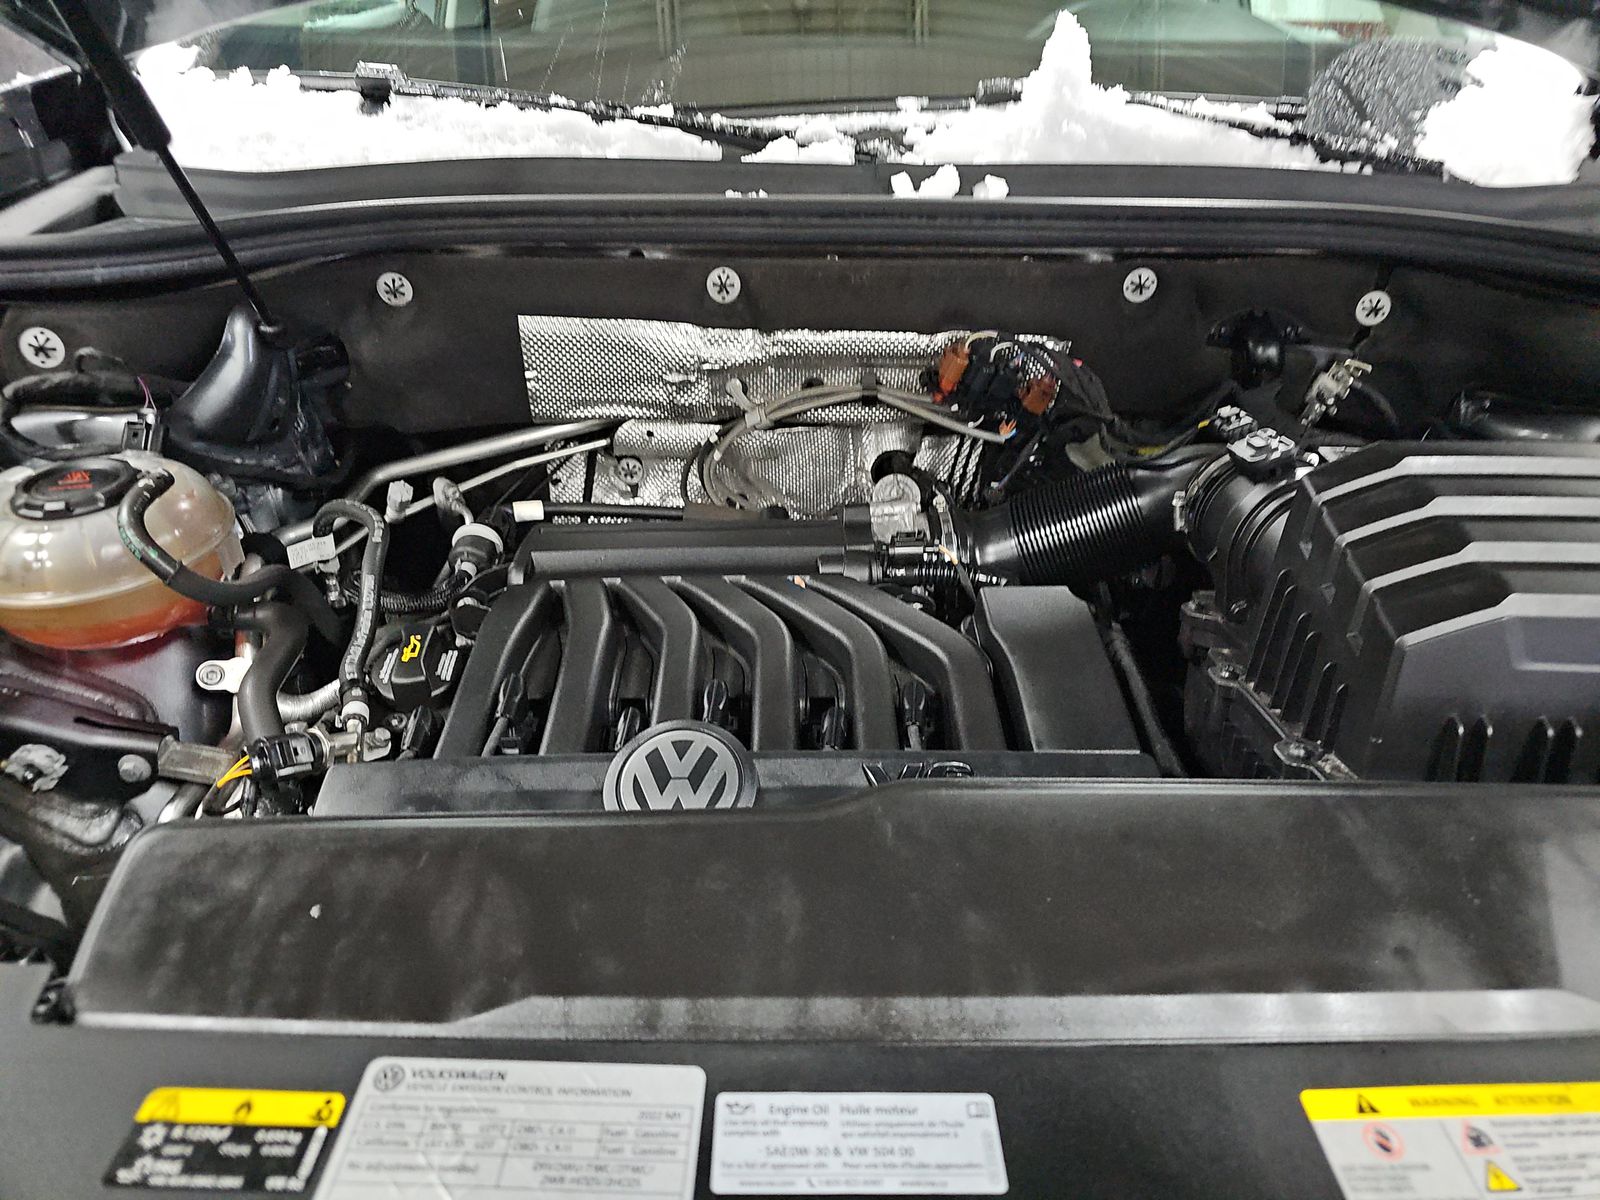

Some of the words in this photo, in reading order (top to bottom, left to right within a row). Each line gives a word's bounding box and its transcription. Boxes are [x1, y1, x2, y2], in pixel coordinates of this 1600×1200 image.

[768, 1104, 809, 1117] Engine
[812, 1104, 830, 1115] Oil
[840, 1104, 872, 1115] Huile
[875, 1104, 918, 1115] moteur
[833, 1145, 842, 1157] &
